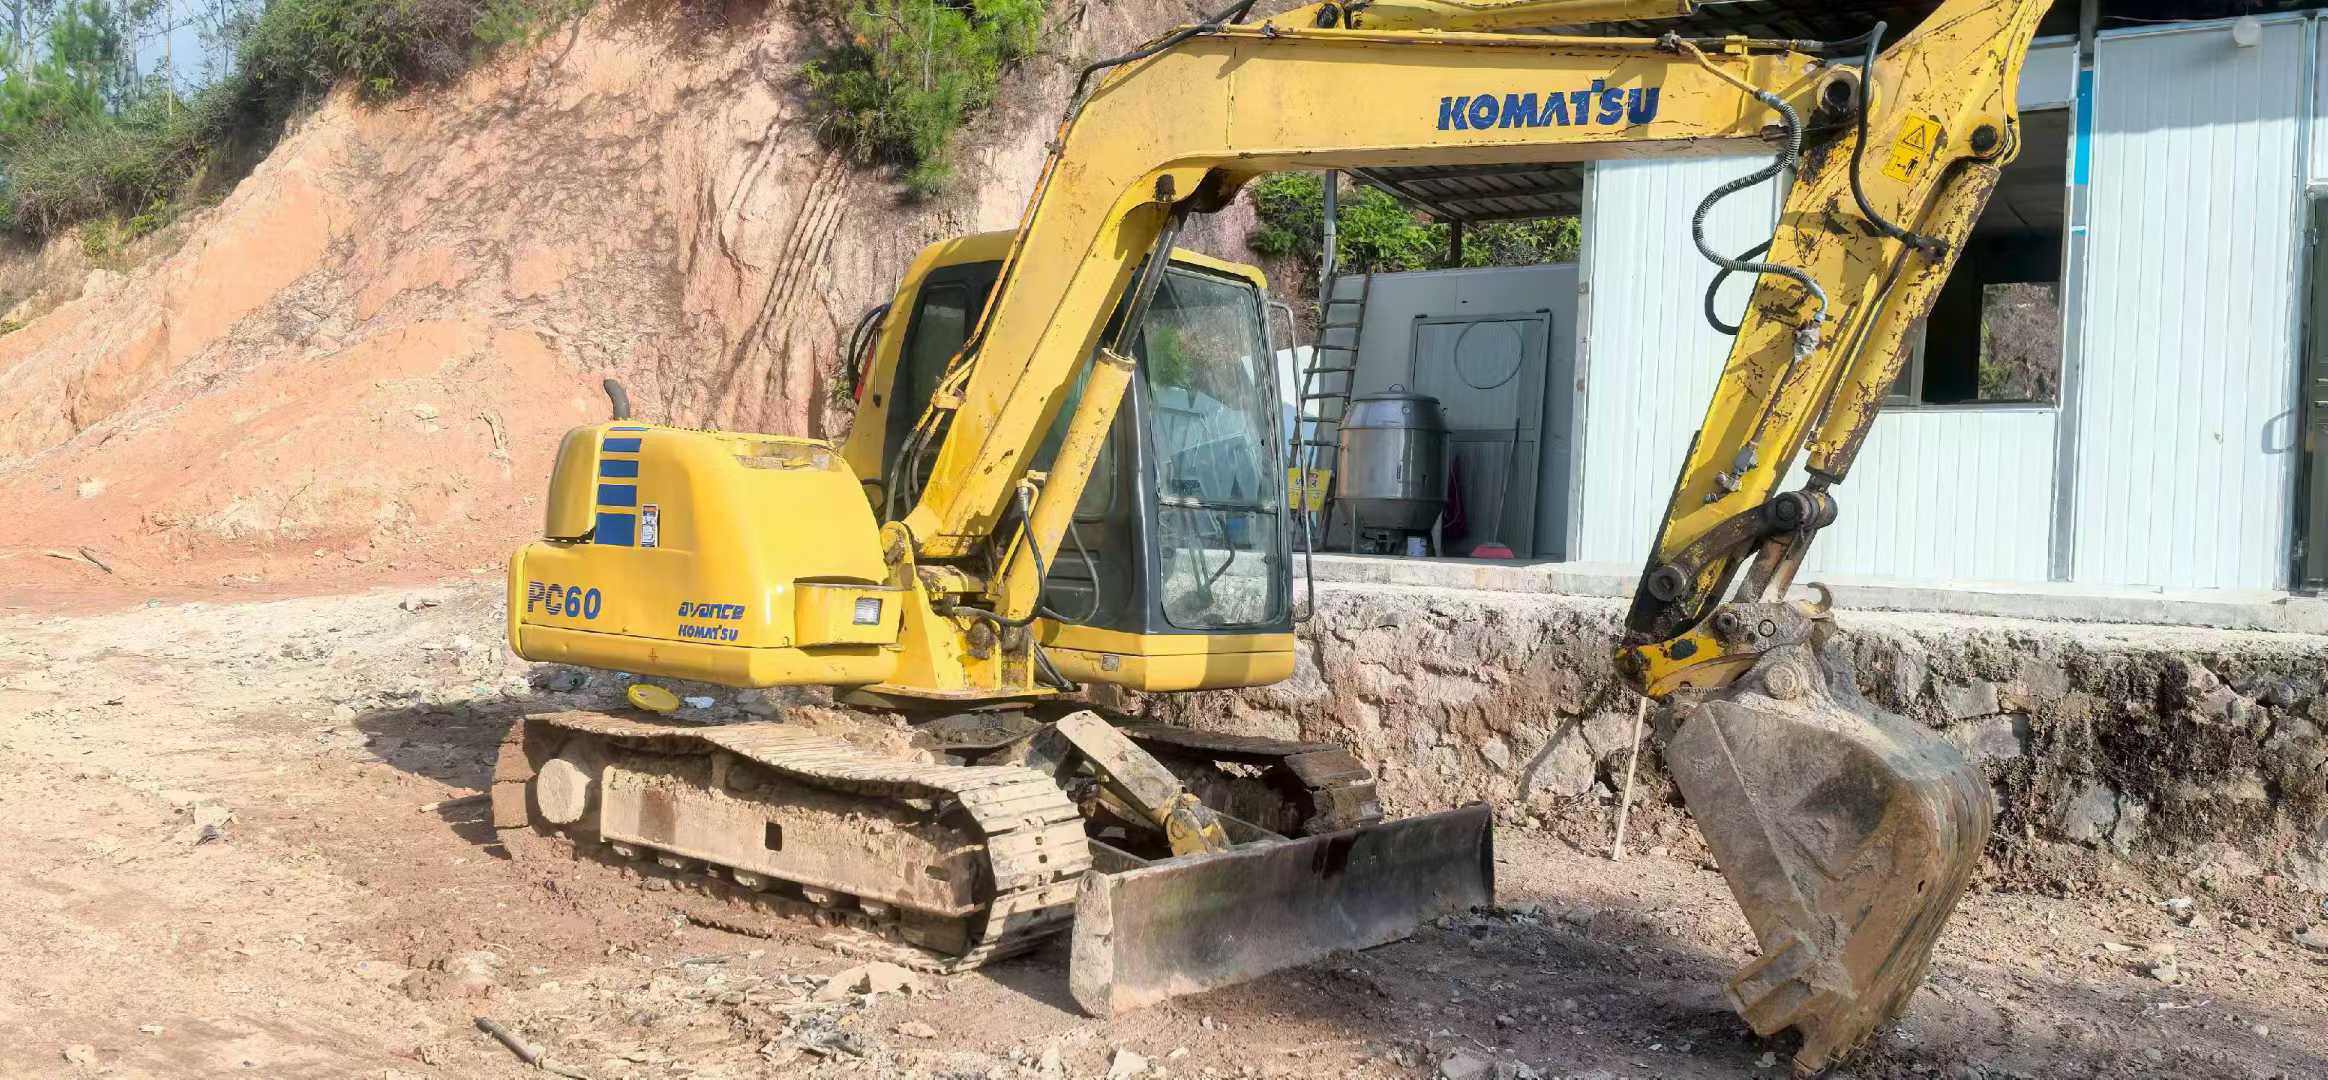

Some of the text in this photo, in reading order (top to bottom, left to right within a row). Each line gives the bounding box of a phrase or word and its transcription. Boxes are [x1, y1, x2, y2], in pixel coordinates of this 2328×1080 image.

[1437, 79, 1660, 131] KOMATSU
[527, 581, 602, 620] PC60
[678, 624, 739, 641] KOMATSU
